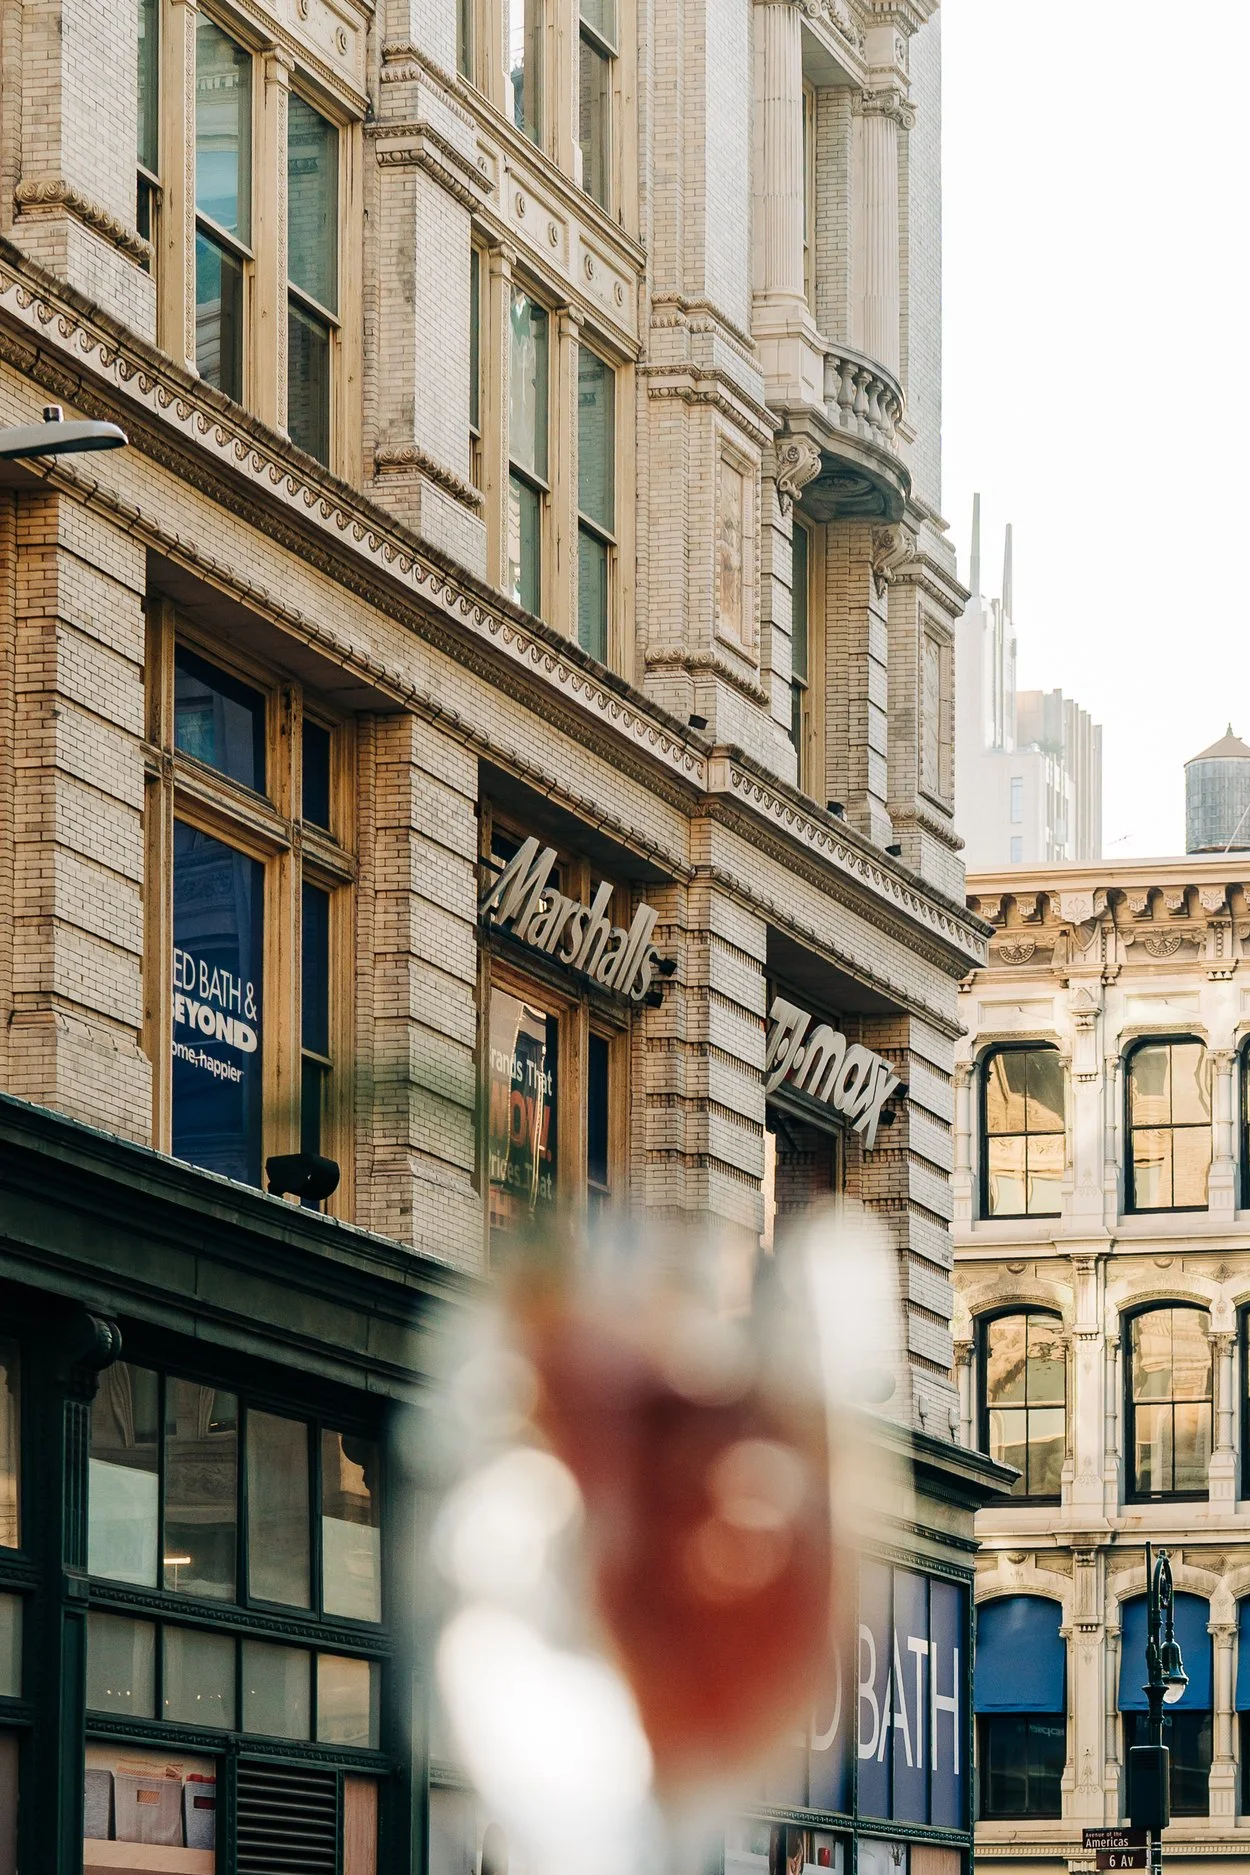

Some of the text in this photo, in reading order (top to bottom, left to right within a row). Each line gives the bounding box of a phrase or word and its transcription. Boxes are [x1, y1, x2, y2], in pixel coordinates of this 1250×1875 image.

[478, 836, 660, 1001] Marshalls
[172, 947, 258, 1021] ED BATH &
[490, 1044, 552, 1096] rands That
[857, 1624, 959, 1775] BATH
[1085, 1836, 1129, 1848] Americas
[1109, 1854, 1134, 1867] 6 Av
